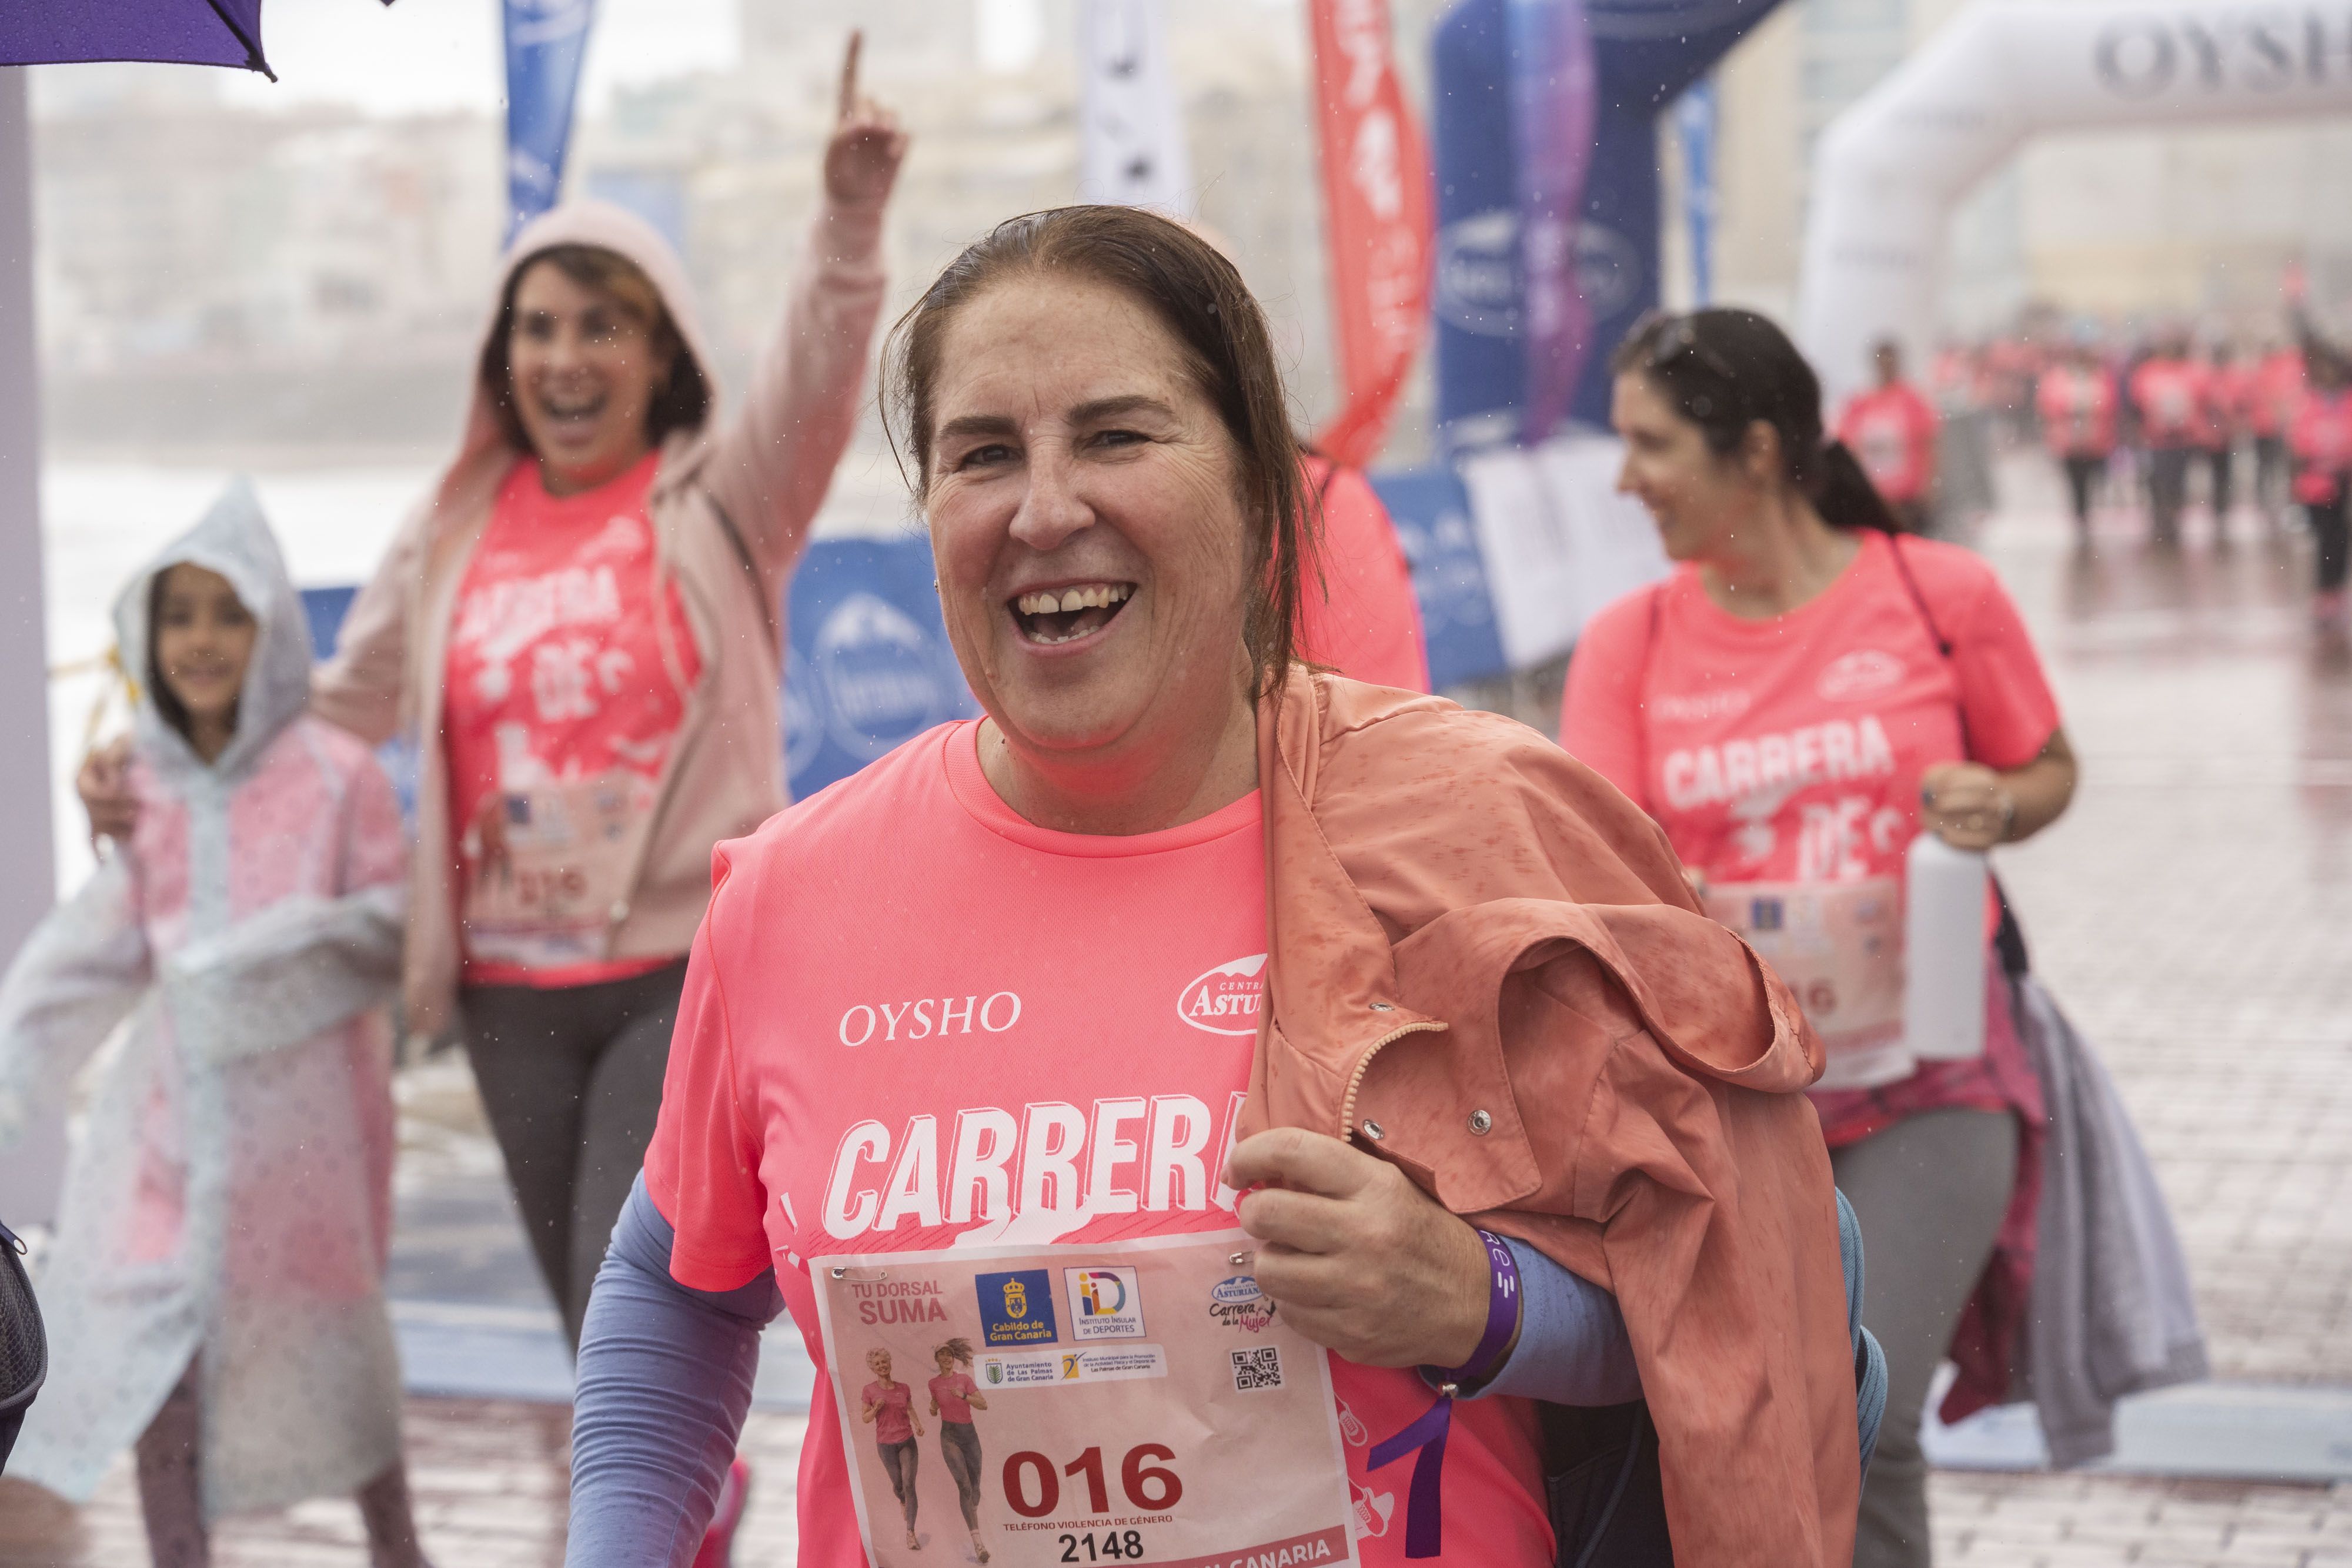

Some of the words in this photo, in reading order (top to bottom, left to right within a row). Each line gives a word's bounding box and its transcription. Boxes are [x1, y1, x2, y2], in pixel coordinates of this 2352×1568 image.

[1664, 714, 1896, 812] CARRERA
[1220, 981, 1263, 991] CENTR
[1188, 985, 1262, 1017] ASTU
[838, 991, 1022, 1047] OYSHO
[851, 1283, 872, 1298] TU
[876, 1280, 943, 1298] DORSAL
[858, 1297, 948, 1325] SUMA
[1210, 1303, 1255, 1317] Carrera
[993, 1322, 1029, 1332] Cabildo
[1031, 1320, 1044, 1329] de
[1093, 1324, 1135, 1334] DEPORTES
[1222, 1316, 1231, 1326] de
[1232, 1316, 1239, 1325] la
[1238, 1311, 1272, 1333] Mujer
[990, 1332, 1013, 1341] Gran
[1014, 1329, 1052, 1340] Canaria
[1006, 1362, 1052, 1370] Ayuntamiento
[1002, 1443, 1183, 1518] 016
[1003, 1522, 1055, 1531] TELÉFONO
[1057, 1519, 1112, 1529] VIOLENCIA
[1115, 1517, 1127, 1526] DE
[1130, 1514, 1173, 1525] GÉNERO
[1058, 1530, 1144, 1563] 2148
